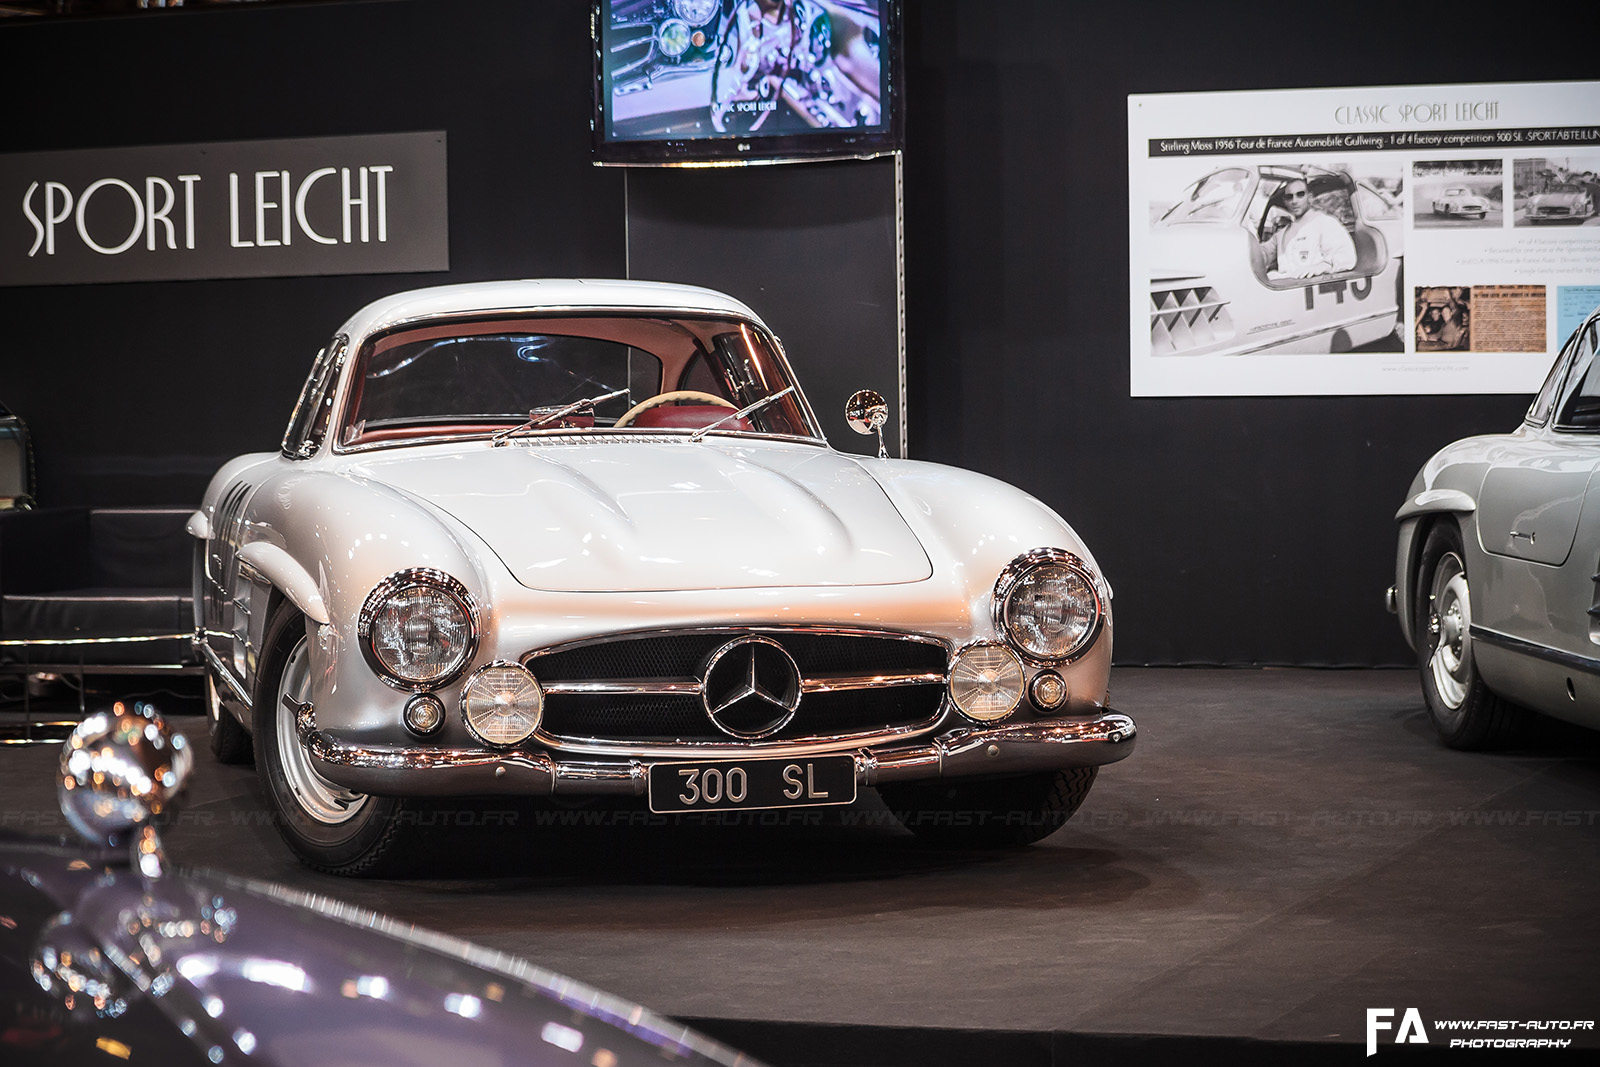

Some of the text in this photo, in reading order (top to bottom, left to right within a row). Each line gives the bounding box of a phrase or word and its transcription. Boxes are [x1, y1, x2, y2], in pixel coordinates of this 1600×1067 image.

[1334, 101, 1499, 125] CLASSIC SPORT LEICHT
[1160, 140, 1190, 154] Stirling
[1191, 140, 1213, 150] Moss
[1215, 138, 1234, 150] 1956
[1235, 138, 1254, 149] Tour
[1256, 138, 1266, 148] de
[1267, 137, 1293, 149] France
[1294, 136, 1343, 147] Automobile
[1344, 134, 1384, 149] Gullwing
[1396, 133, 1406, 145] of
[1406, 133, 1413, 144] 4
[1414, 132, 1442, 146] factory
[1443, 130, 1495, 146] competition
[1512, 130, 1523, 141] SL
[22, 165, 394, 257] SPORT LEICHT
[678, 763, 829, 805] 300 SL
